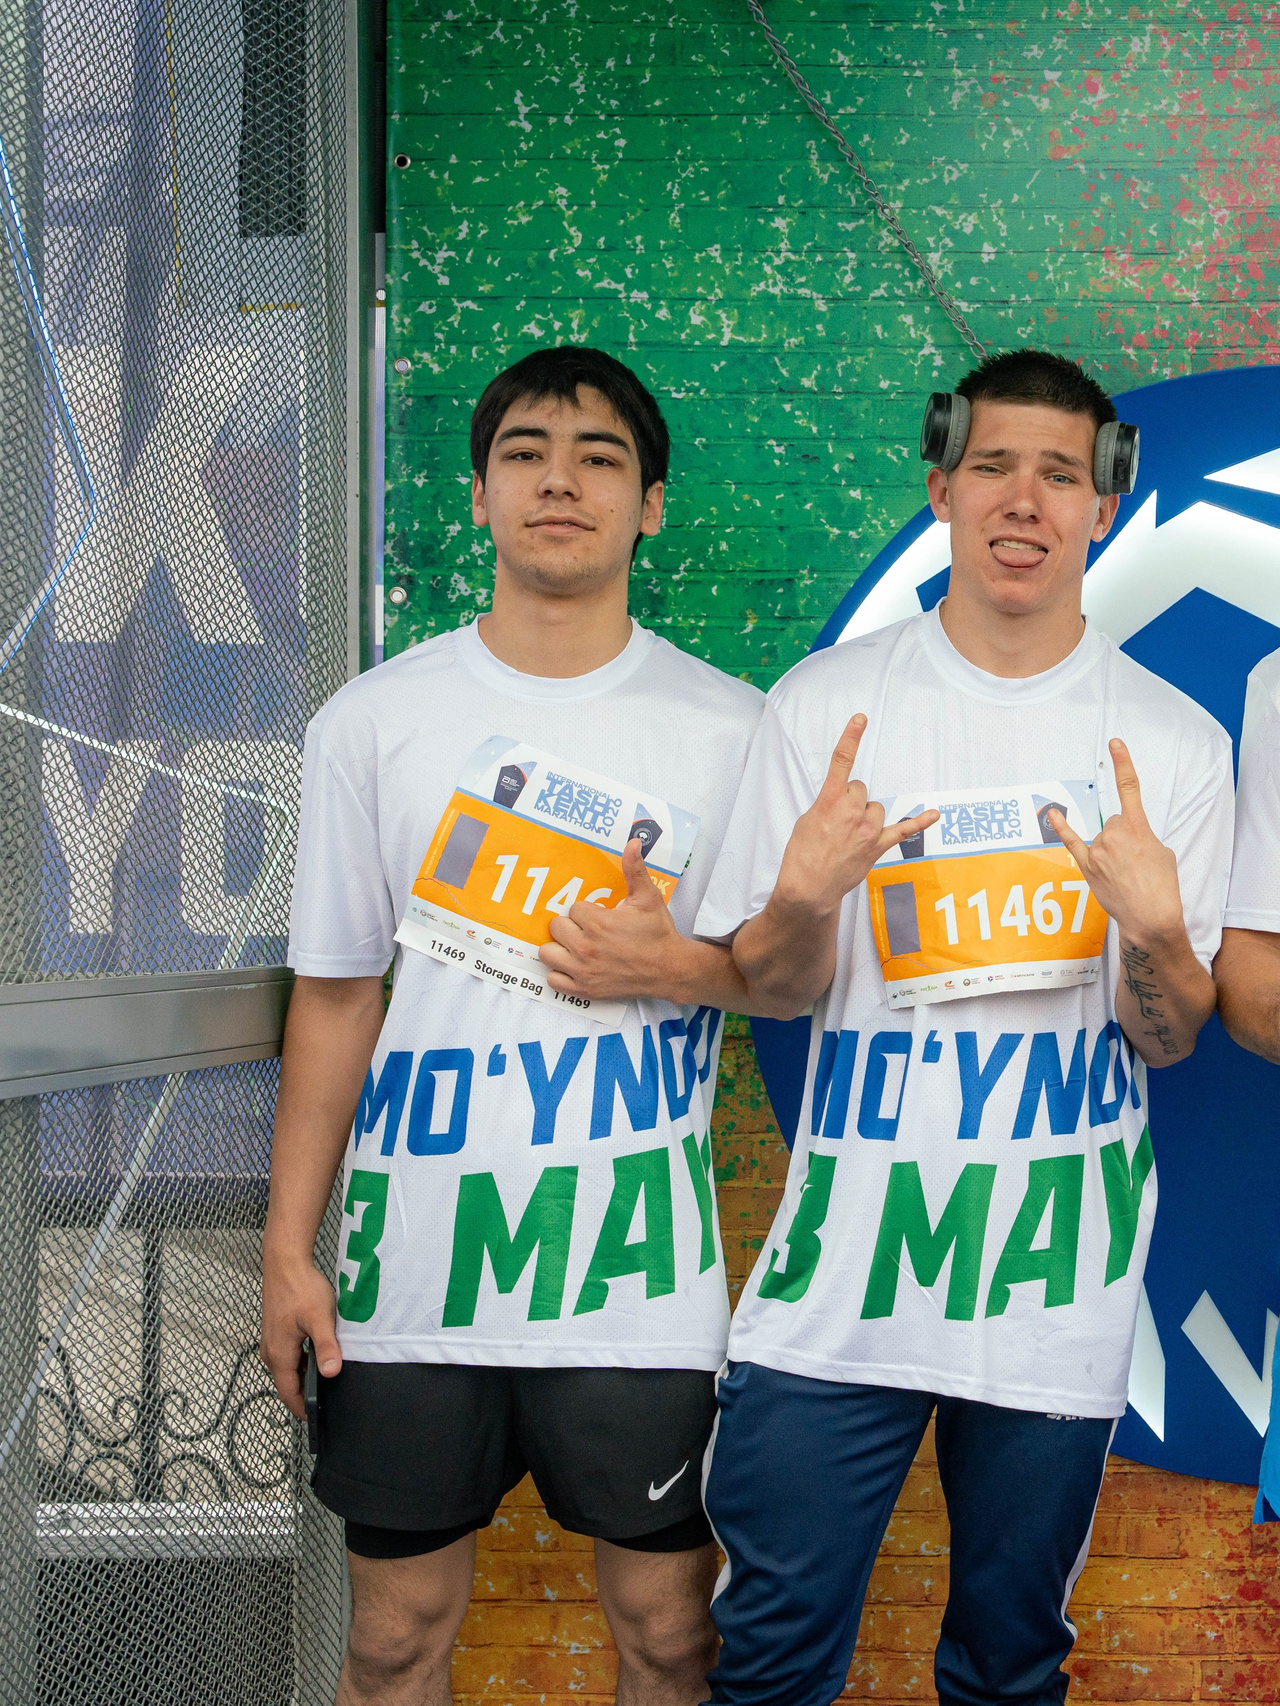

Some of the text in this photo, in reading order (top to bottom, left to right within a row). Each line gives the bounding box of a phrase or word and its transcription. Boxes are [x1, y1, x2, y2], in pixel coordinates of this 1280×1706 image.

[546, 776, 613, 817] TASH
[548, 771, 610, 799] INTERNATIONAL
[939, 799, 1005, 811] INTERNATIONAL
[537, 789, 605, 827] KENT
[940, 803, 1009, 825] TASH
[941, 820, 1009, 839] KENT
[491, 854, 627, 916] 114
[934, 880, 1090, 945] 11467
[430, 939, 466, 962] 11469
[474, 959, 518, 985] Storage
[520, 978, 544, 996] Bag
[553, 989, 591, 1010] 11469
[337, 1131, 717, 1328] 3 MAY
[757, 1121, 1155, 1322] 3 MAY
